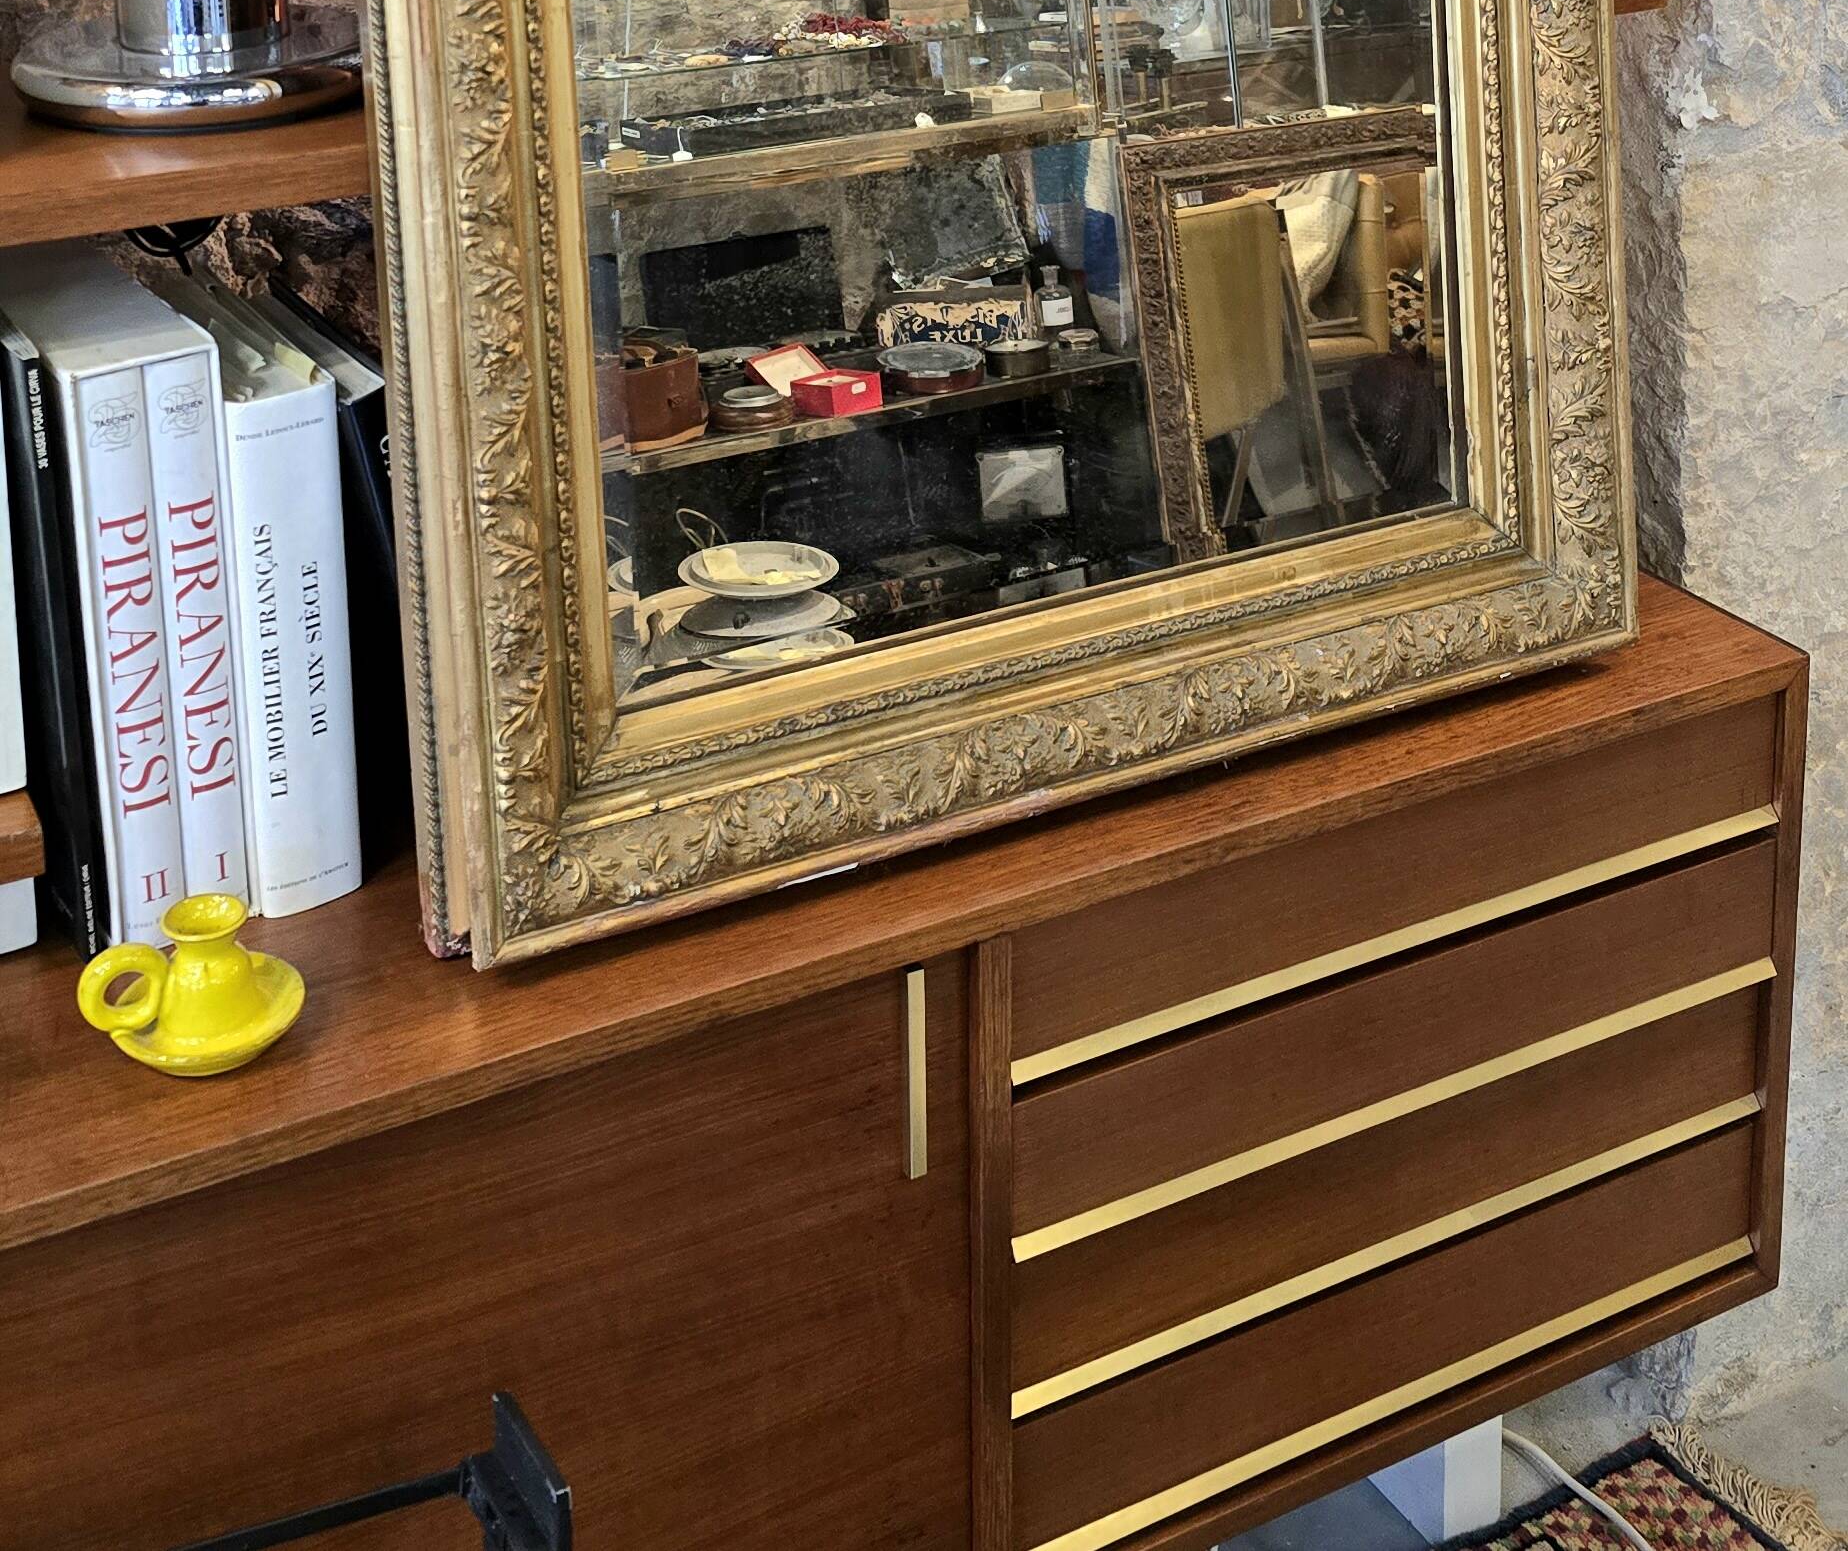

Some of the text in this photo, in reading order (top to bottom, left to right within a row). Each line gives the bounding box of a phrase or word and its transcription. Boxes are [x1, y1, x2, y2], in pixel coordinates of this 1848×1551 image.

[94, 413, 135, 428] TASCHEN
[164, 399, 204, 415] TASCHEN
[298, 560, 324, 645] SIÈCLE
[98, 504, 171, 819] PIRANESI
[167, 489, 237, 801] PIRANESI
[252, 522, 289, 799] LE MOBILIER FRANÇAIS
[309, 701, 328, 738] DU
[214, 850, 230, 882] I
[141, 867, 171, 904] II
